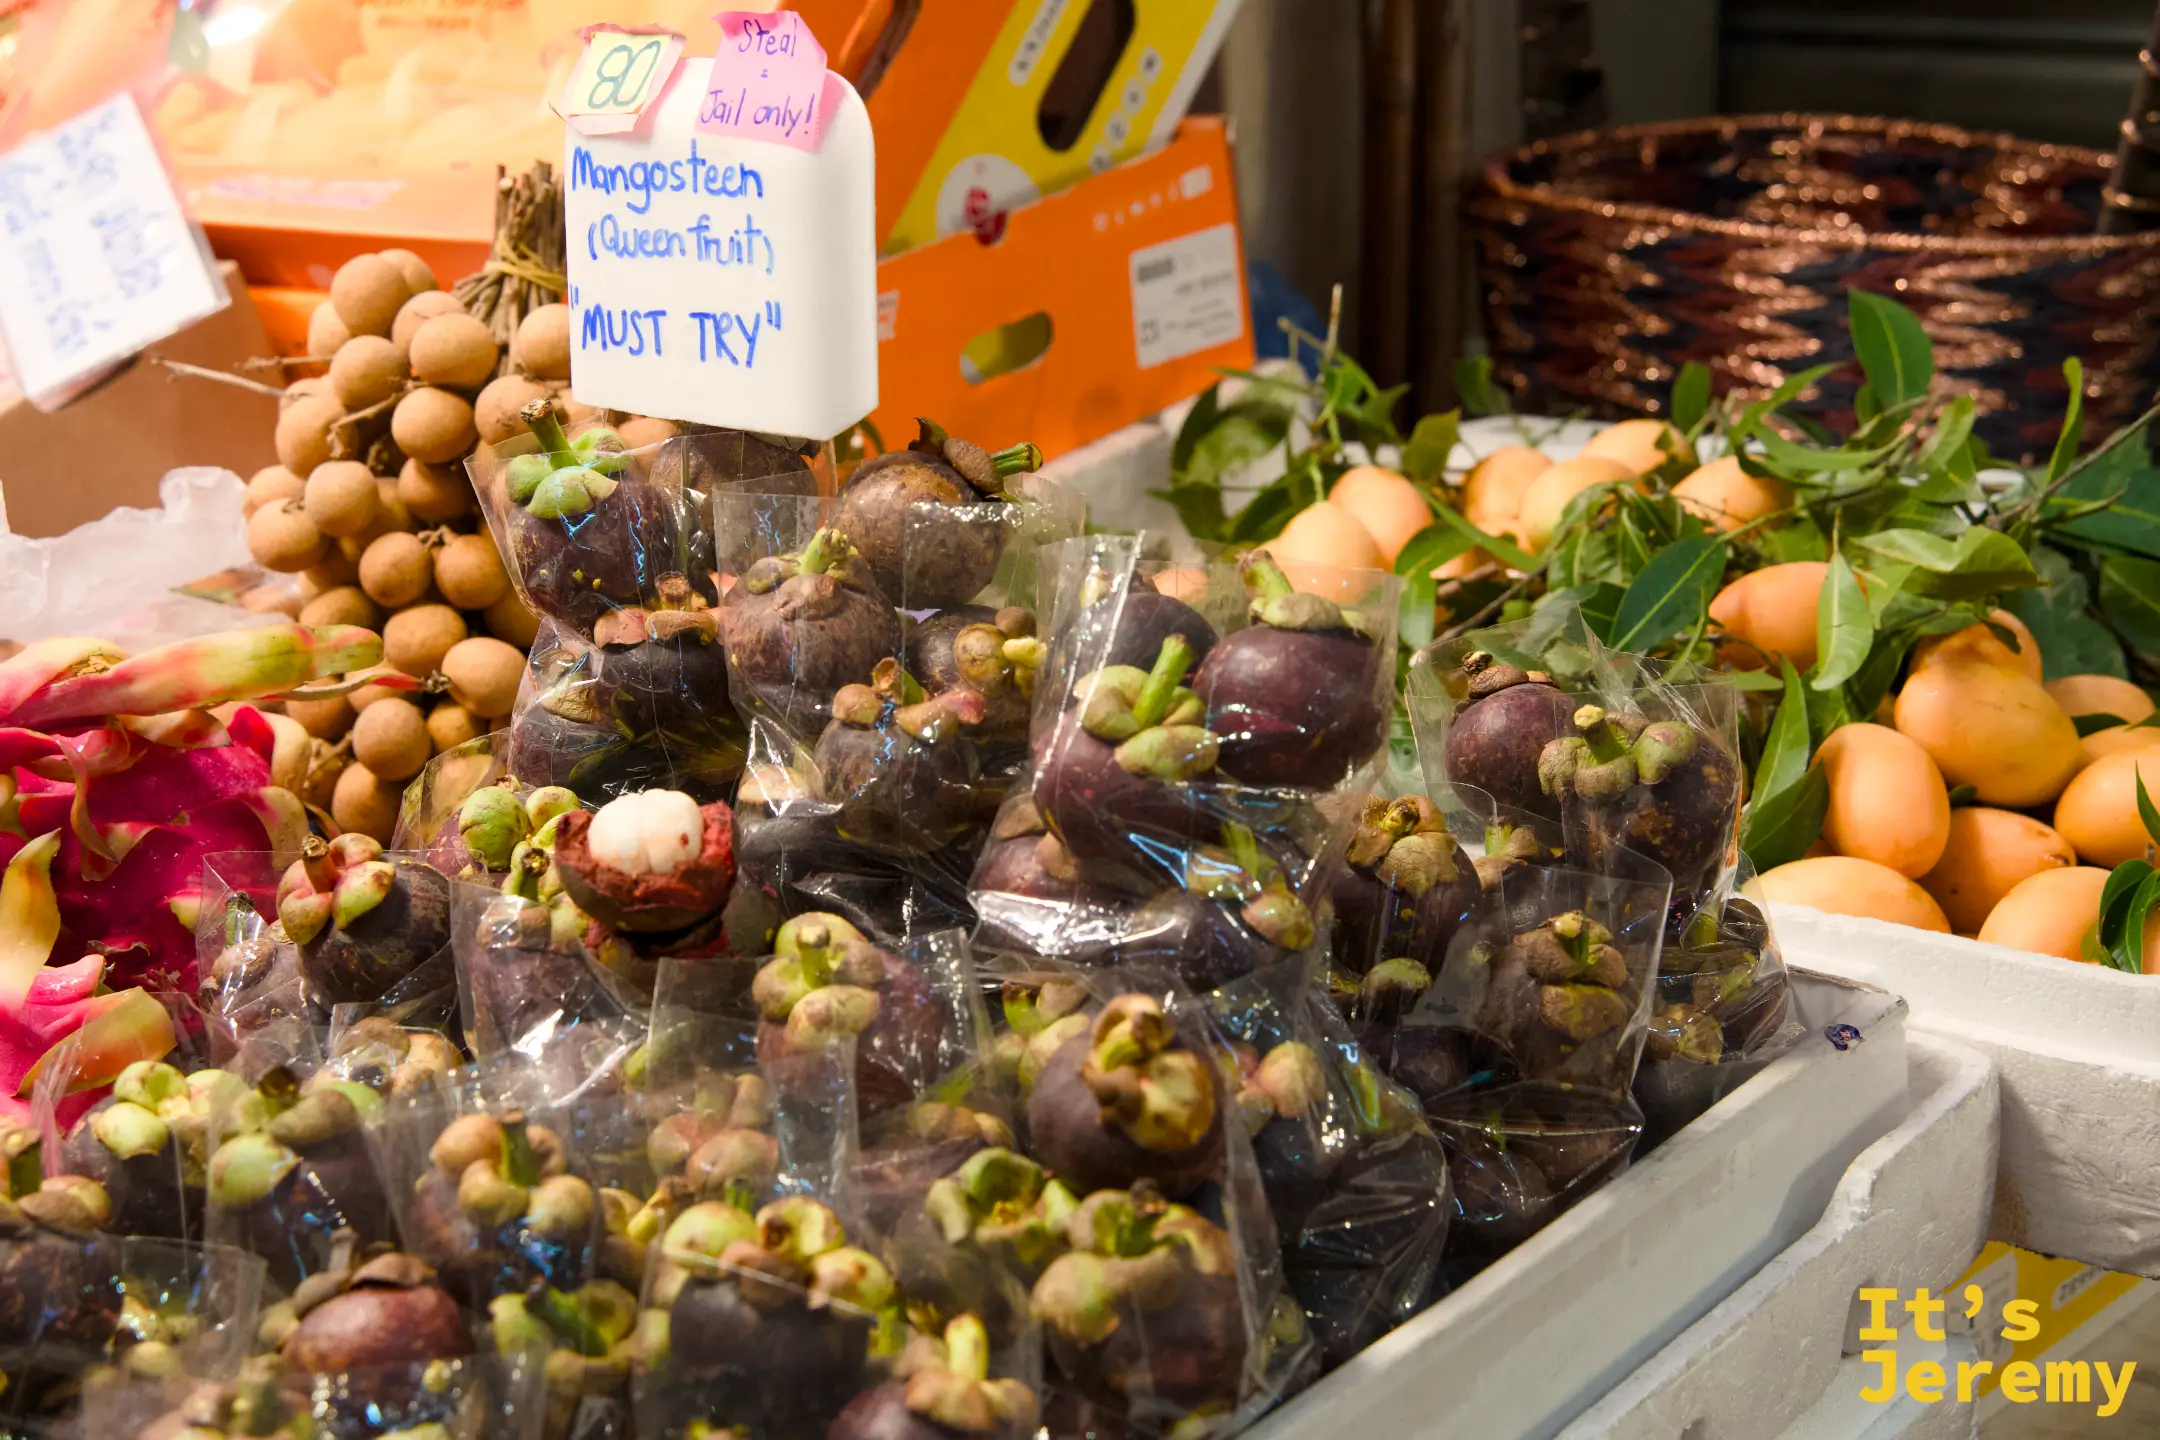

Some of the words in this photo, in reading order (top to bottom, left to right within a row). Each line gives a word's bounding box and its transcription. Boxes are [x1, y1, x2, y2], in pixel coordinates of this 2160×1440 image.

[738, 18, 797, 57] Steal
[588, 40, 661, 109] 80
[701, 88, 746, 126] Jail
[753, 93, 815, 137] only!
[572, 138, 763, 214] Mangosteen
[570, 284, 667, 357] "MUST
[689, 301, 781, 369] TRY"
